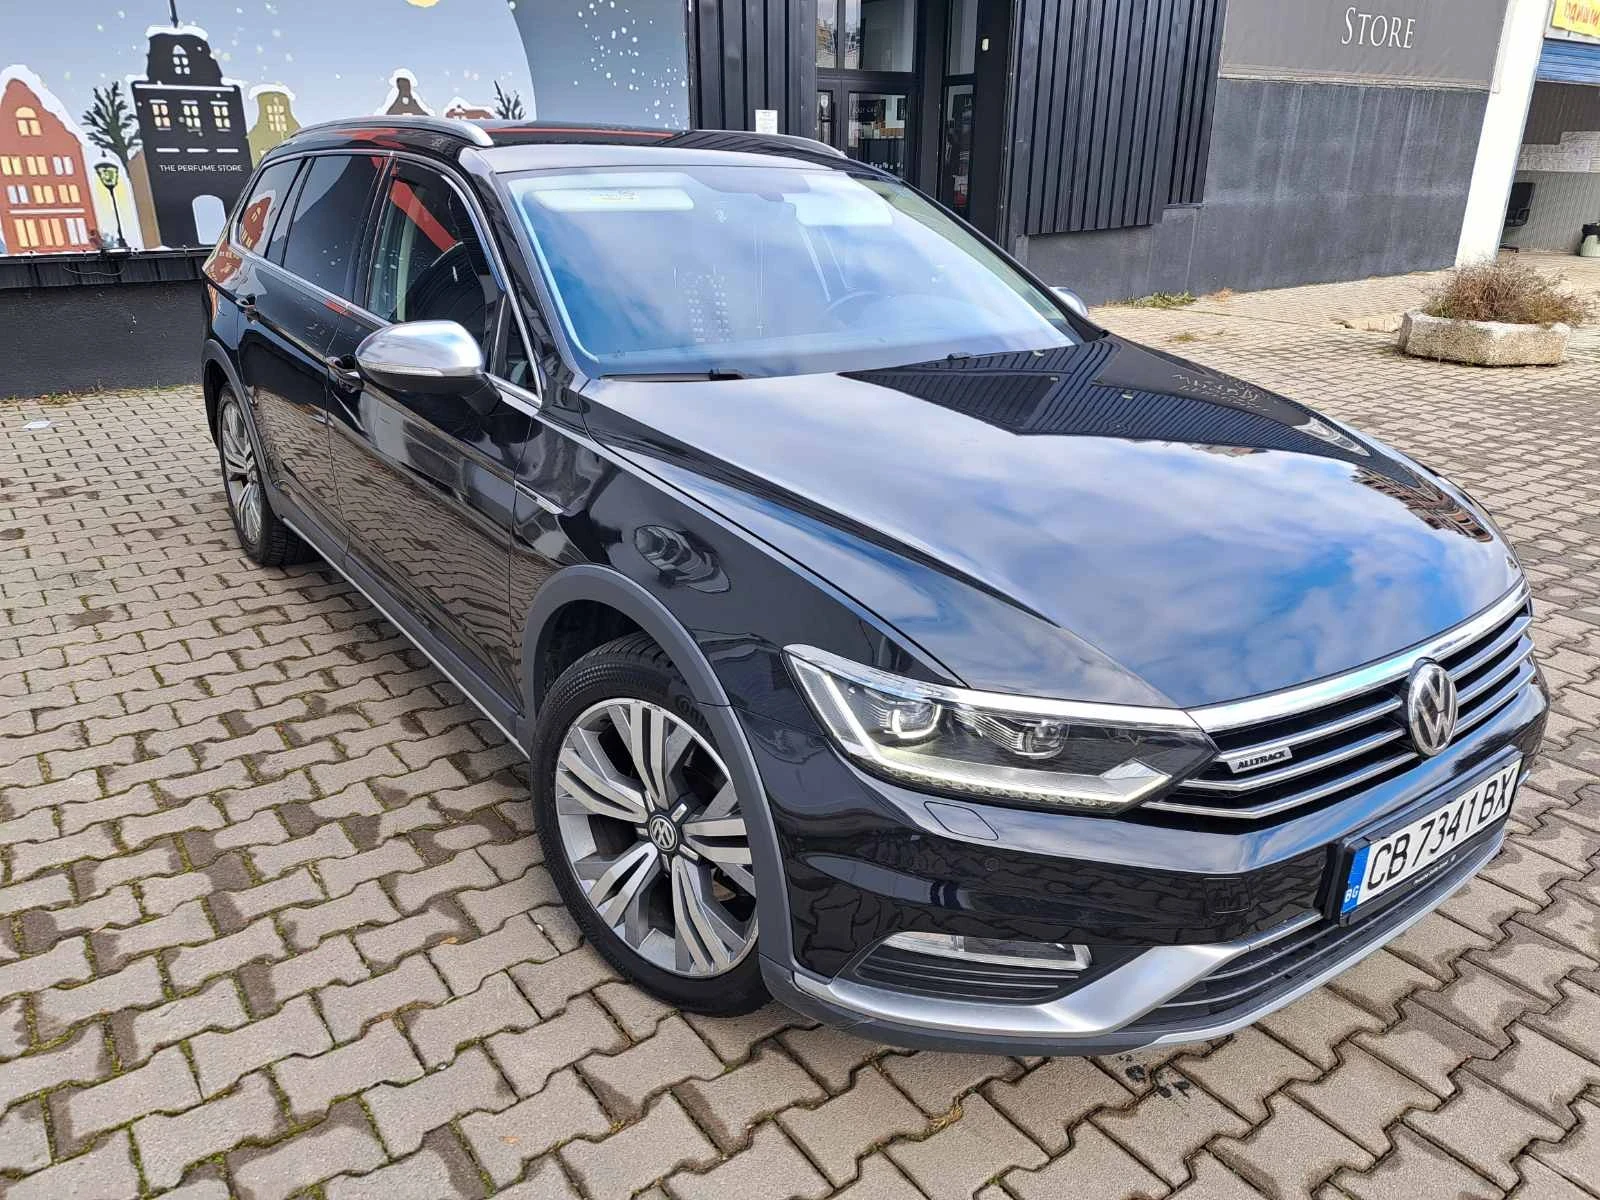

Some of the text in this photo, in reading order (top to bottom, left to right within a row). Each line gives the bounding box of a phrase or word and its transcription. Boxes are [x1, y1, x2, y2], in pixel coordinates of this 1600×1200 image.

[159, 164, 244, 172] THE PERFUME STORE
[1237, 750, 1286, 770] ALLTRACK
[1343, 884, 1360, 905] BG
